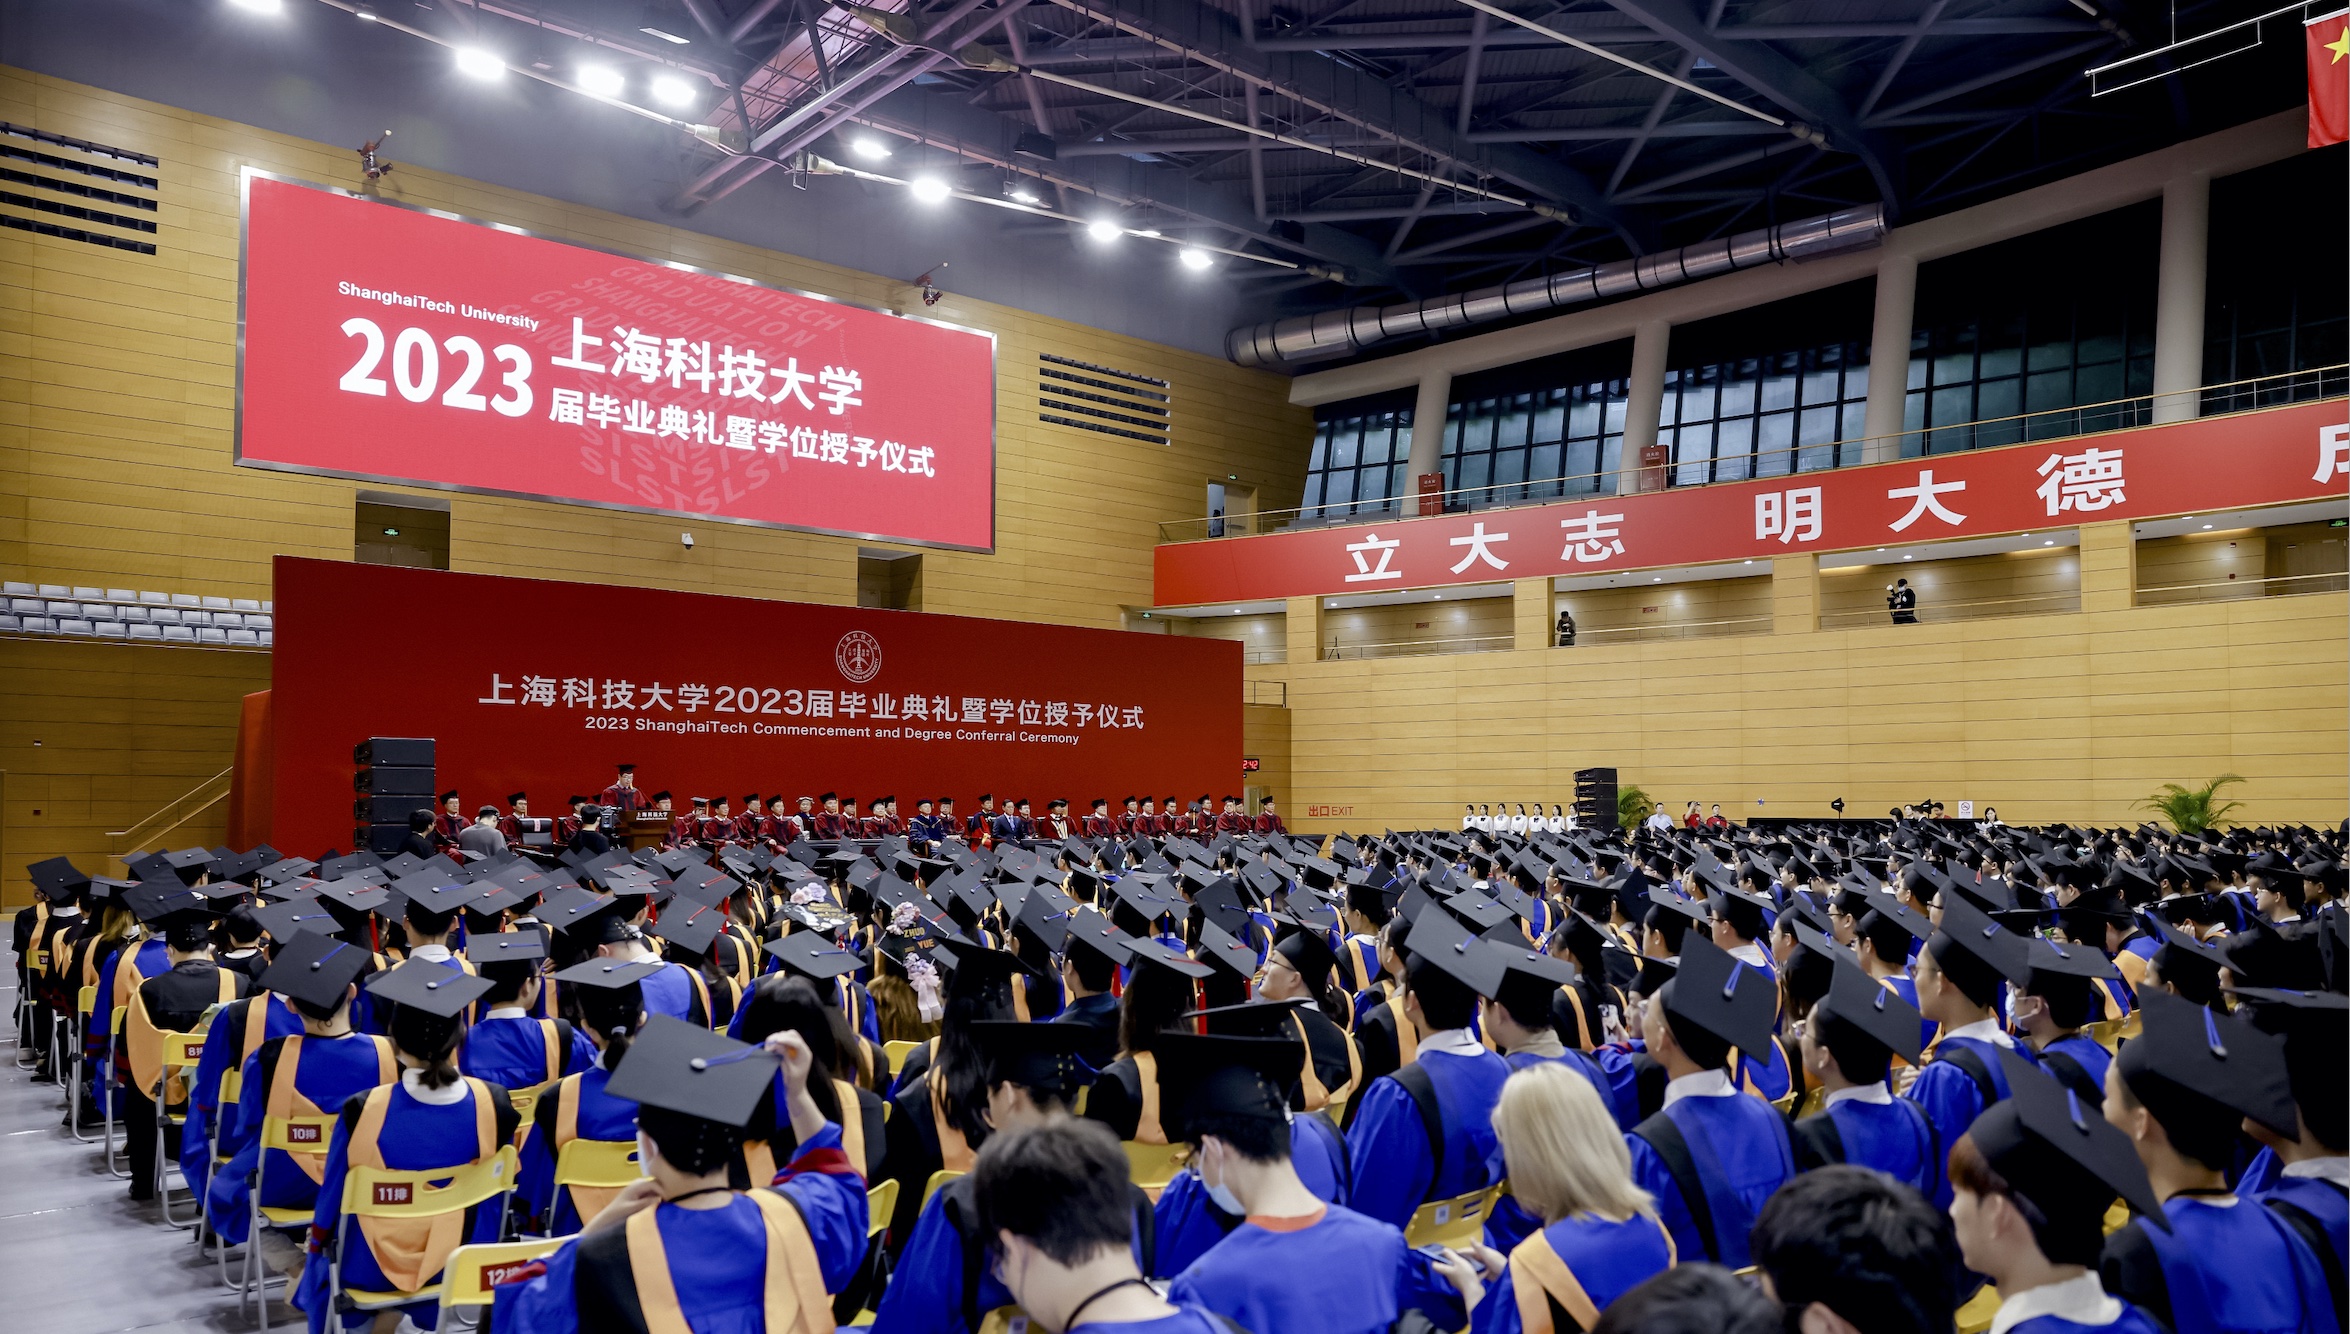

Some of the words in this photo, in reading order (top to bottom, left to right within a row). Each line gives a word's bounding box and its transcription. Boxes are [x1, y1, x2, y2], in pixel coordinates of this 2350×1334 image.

[338, 281, 456, 315] ShanghaiTech
[461, 303, 540, 332] University
[610, 265, 820, 349] GRADUATION
[339, 317, 534, 418] 2023
[550, 316, 863, 416] 上海科技大学
[548, 387, 935, 478] 届毕业典礼暨学位授予仪式
[1344, 510, 1625, 583] 立大志
[1754, 447, 2127, 545] 明大德
[478, 673, 1144, 730] 上海科技大学2023届毕业典礼暨学位授予仪式
[585, 716, 629, 730] 2023
[635, 718, 748, 734] ShanghaiTech
[753, 722, 871, 738] Commencement
[875, 727, 900, 739] and
[905, 727, 952, 742] Degree
[956, 729, 1016, 742] Conferral
[1019, 731, 1079, 745] Ceremony
[1309, 805, 1330, 817] 出口
[1331, 806, 1354, 816] EXIT
[917, 938, 935, 950] YUE
[292, 1128, 317, 1140] 10排
[379, 1187, 408, 1201] 11排
